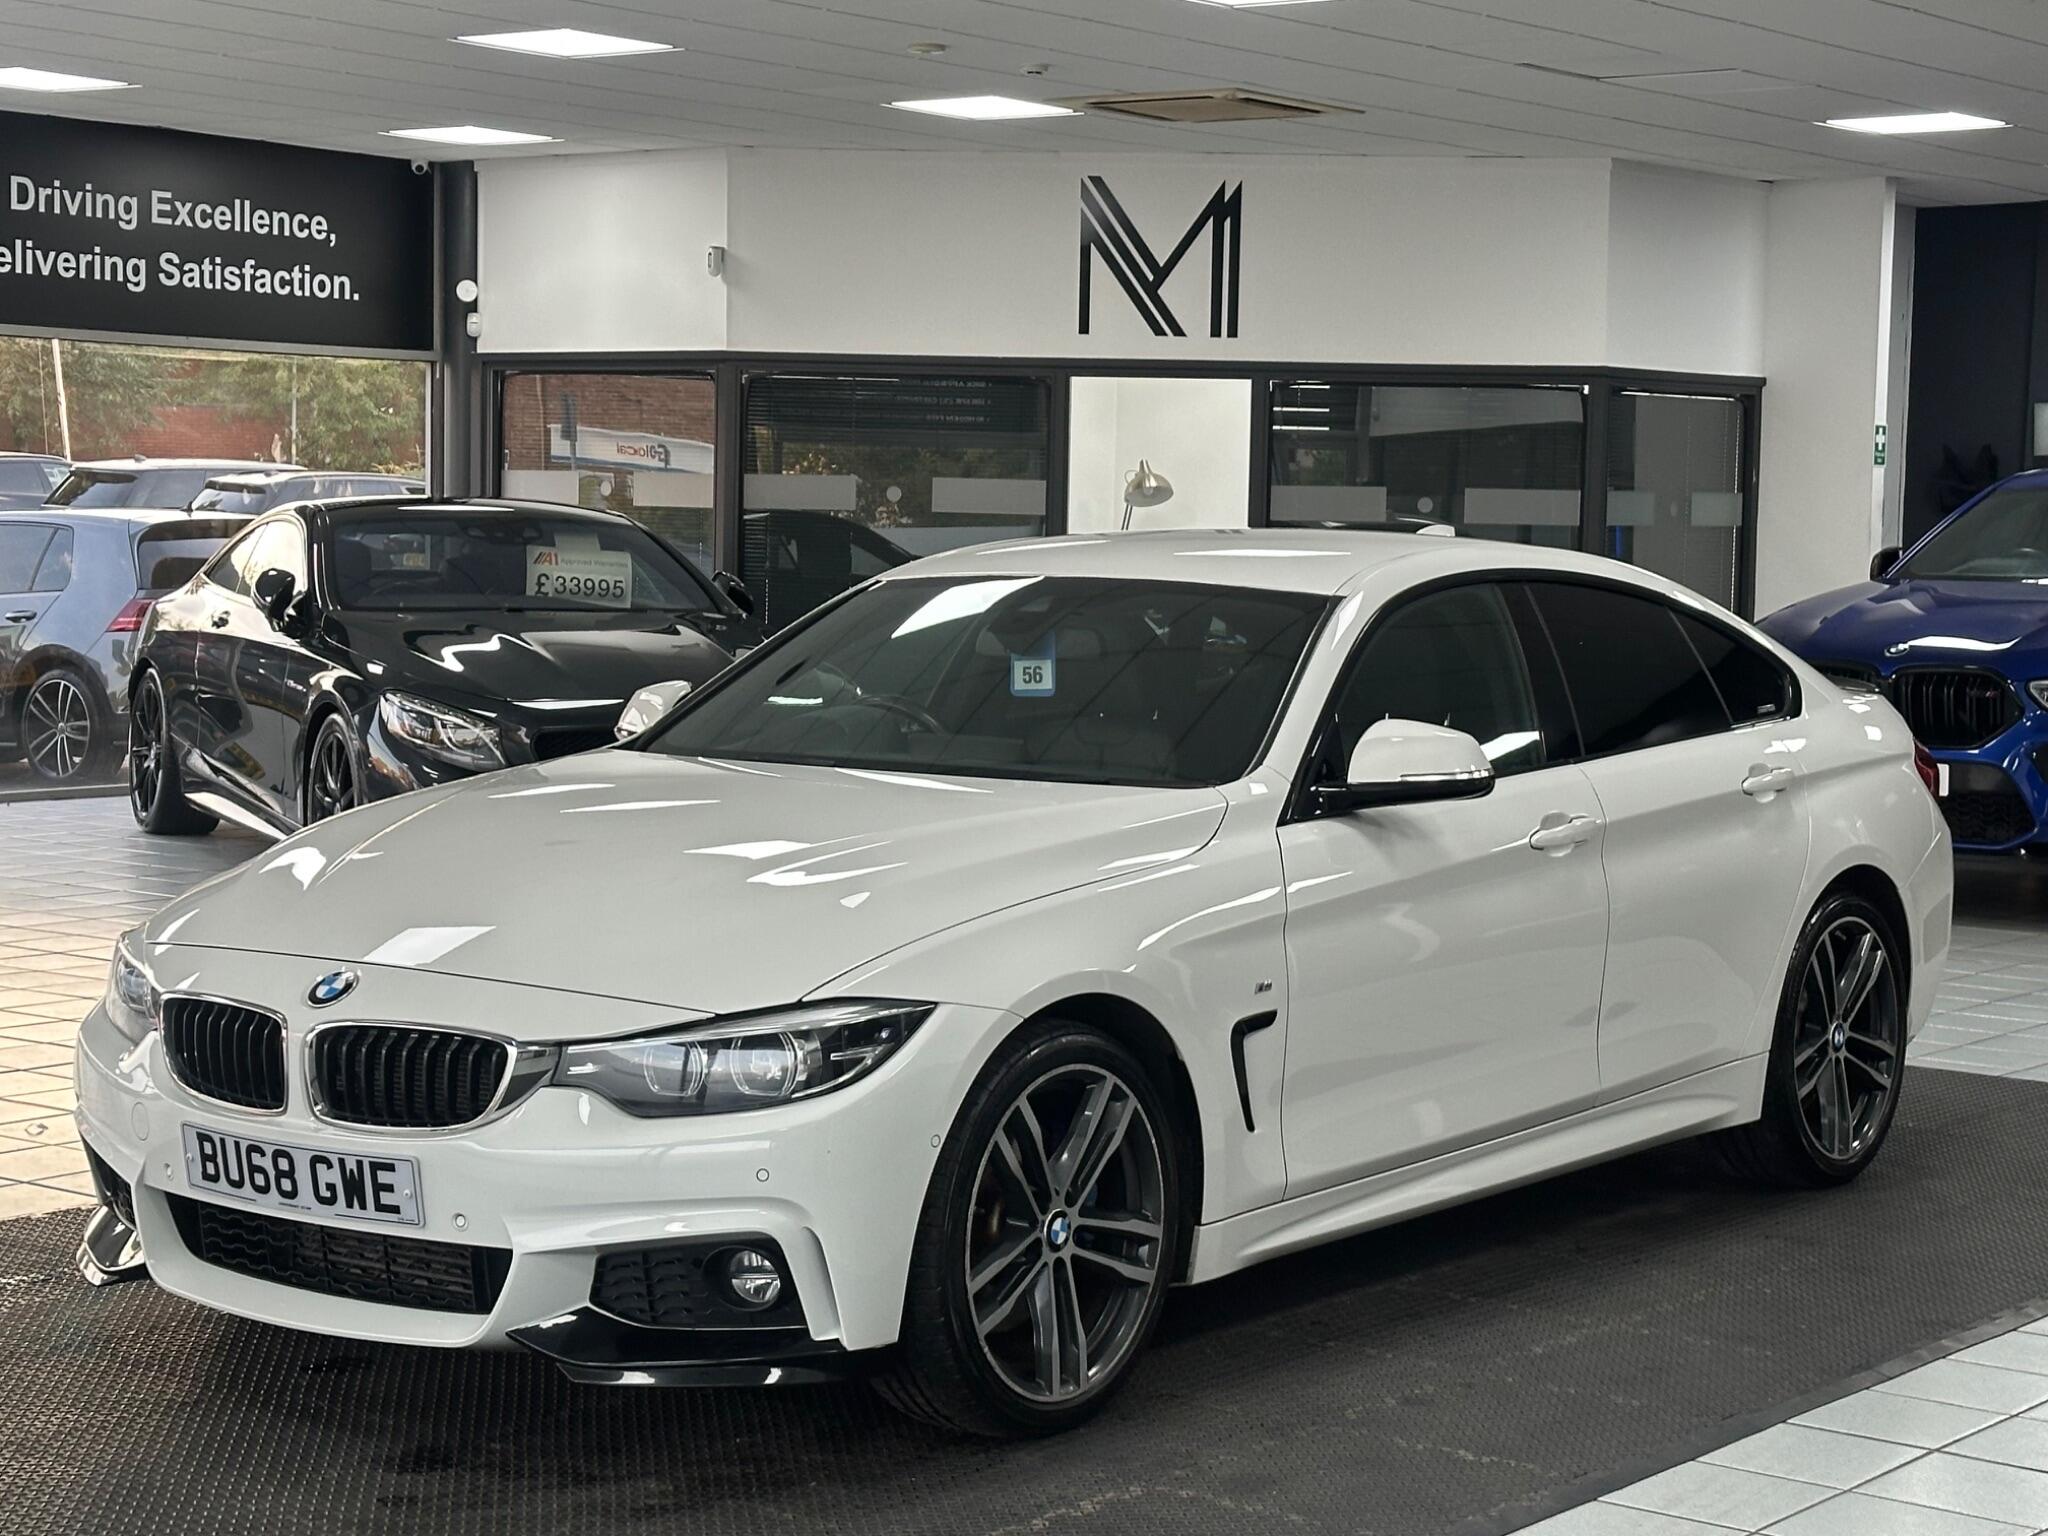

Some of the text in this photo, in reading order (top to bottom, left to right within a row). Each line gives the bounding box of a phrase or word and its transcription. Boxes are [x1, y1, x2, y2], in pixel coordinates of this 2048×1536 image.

[9, 174, 337, 248] Driving Excellence,
[158, 251, 360, 301] Satisfaction.
[1022, 665, 1043, 685] 56
[195, 1131, 401, 1215] BU68 GWE
